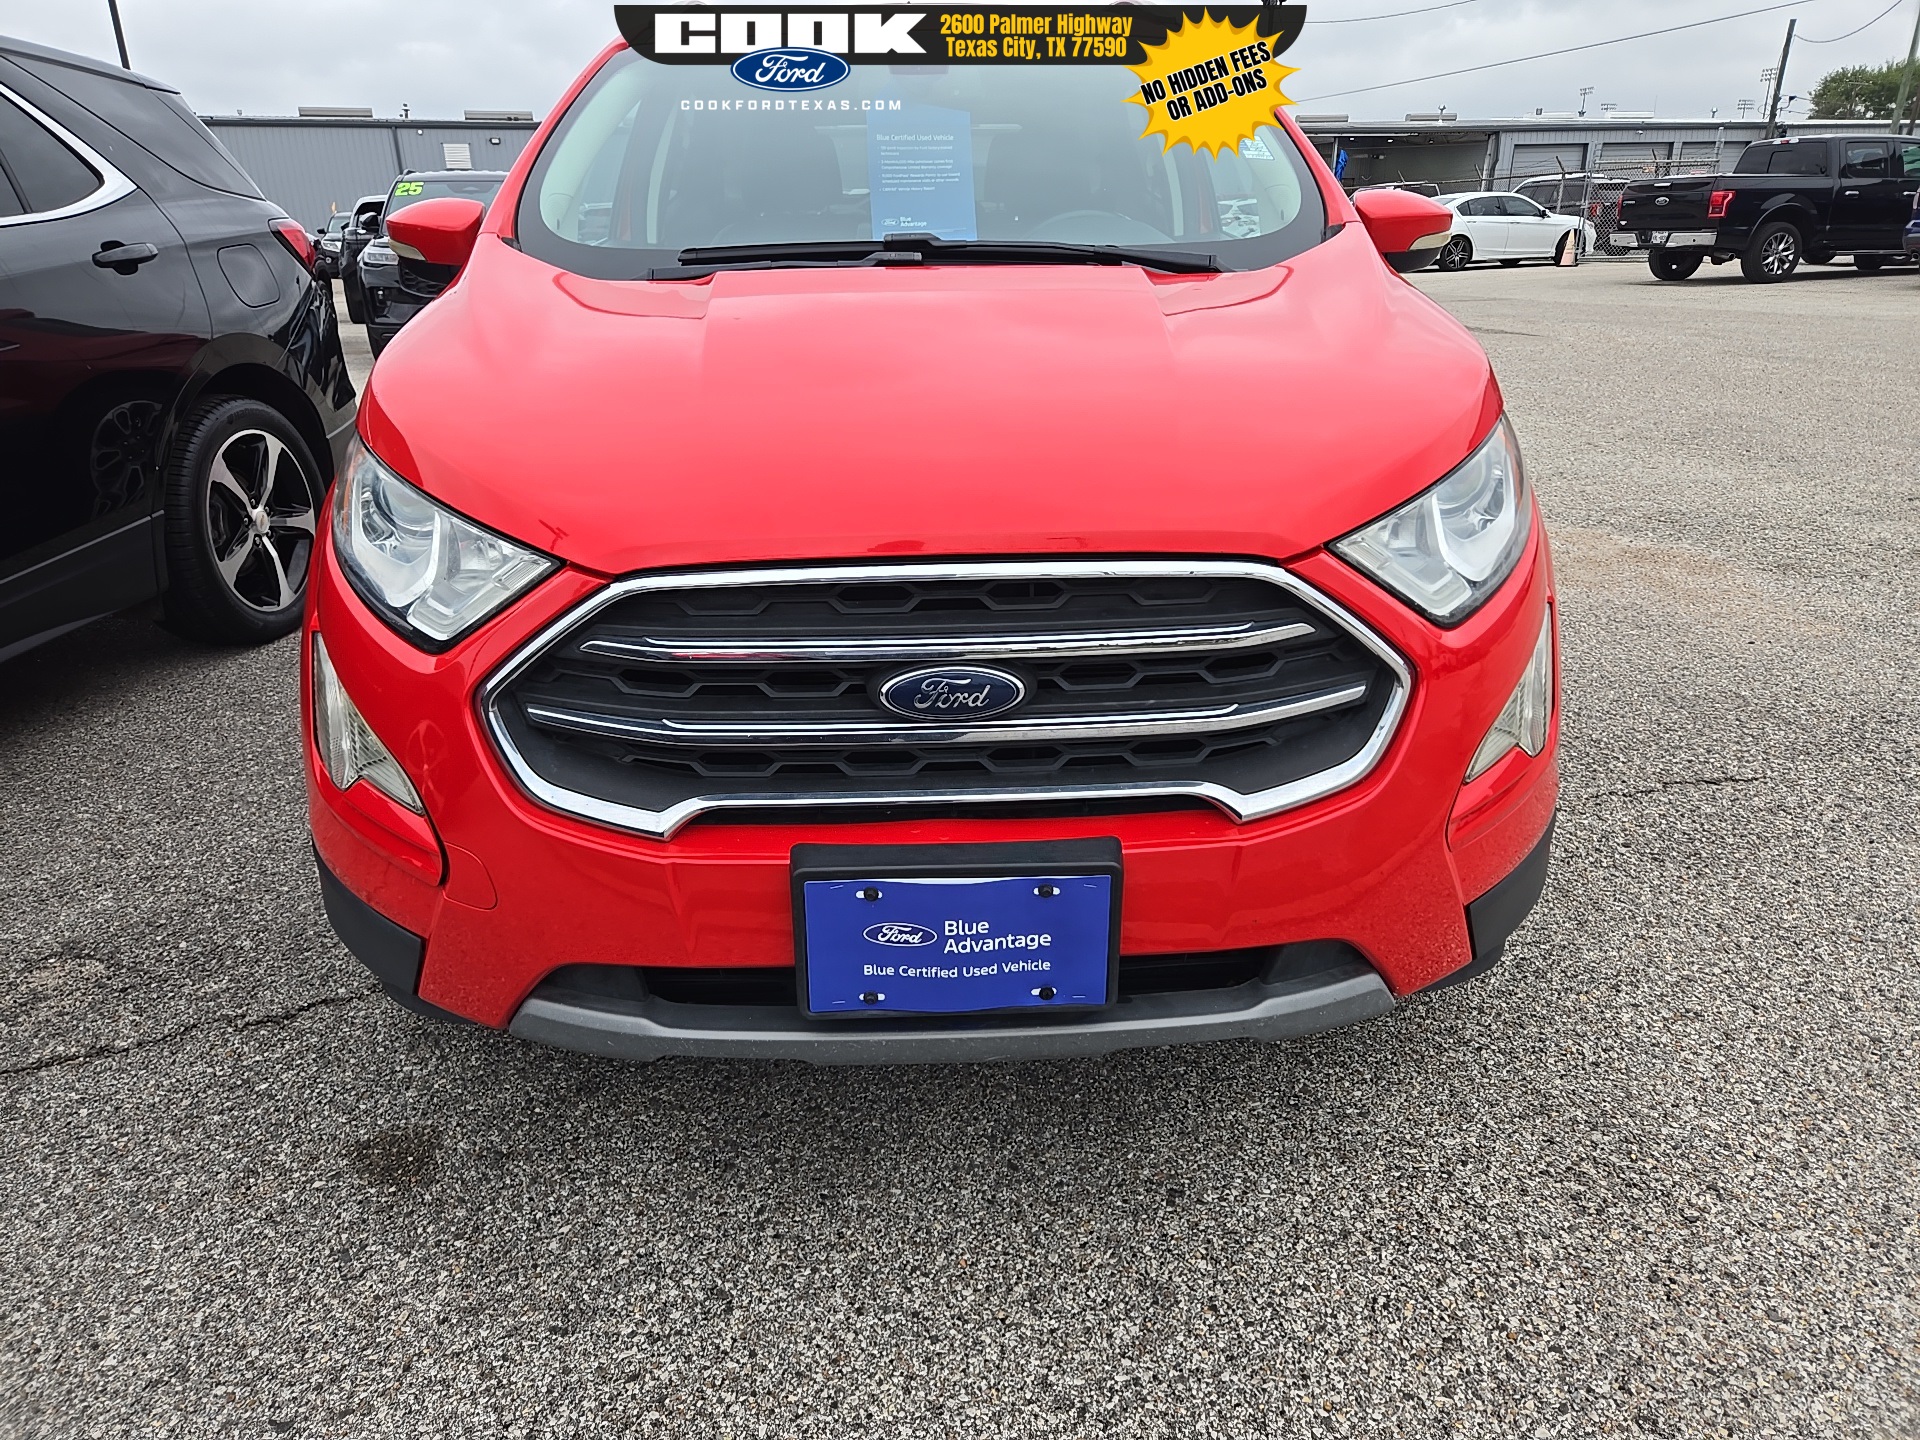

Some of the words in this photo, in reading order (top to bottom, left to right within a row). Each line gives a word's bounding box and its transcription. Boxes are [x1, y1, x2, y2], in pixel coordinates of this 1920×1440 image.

[395, 181, 424, 196] 25
[914, 678, 991, 709] Ford
[877, 925, 924, 944] Ford
[944, 919, 990, 936] Blue
[943, 933, 1052, 954] Advantage
[863, 964, 895, 976] Blue
[899, 965, 958, 979] Certified
[962, 963, 998, 978] Used
[1002, 959, 1051, 973] Vehicle
